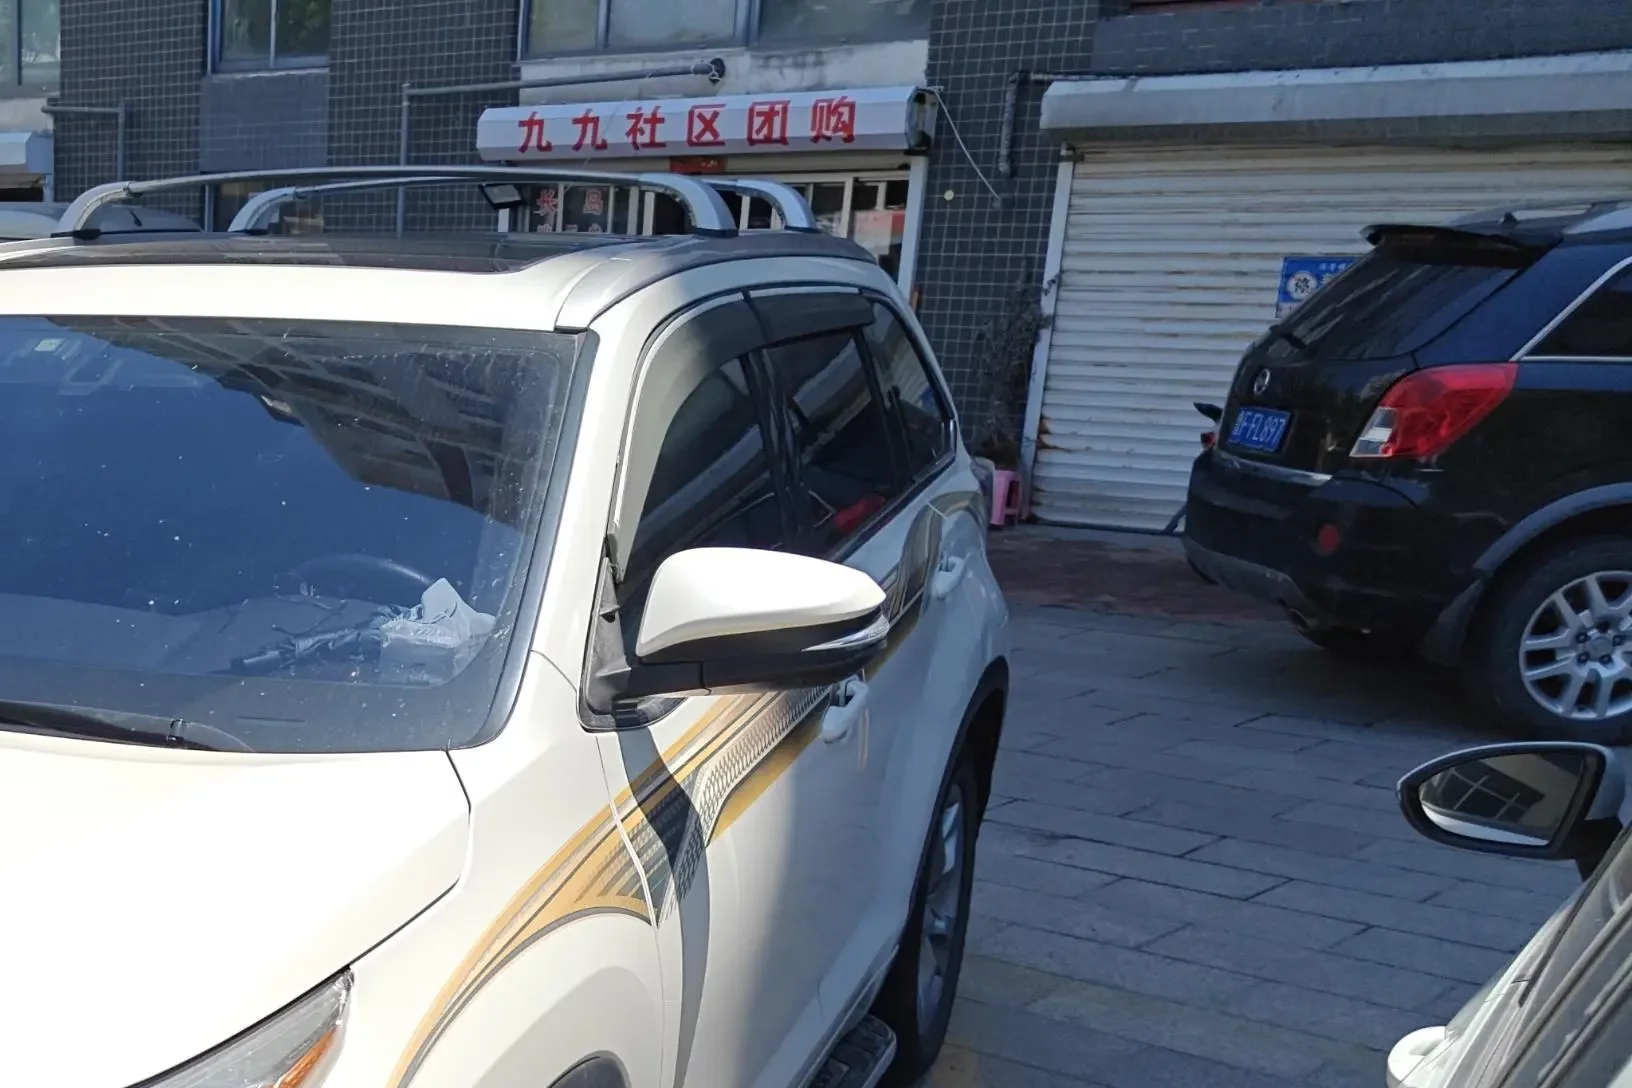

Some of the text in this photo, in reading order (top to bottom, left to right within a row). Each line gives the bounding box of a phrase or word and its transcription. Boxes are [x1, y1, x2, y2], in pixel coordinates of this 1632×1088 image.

[518, 95, 857, 153] 九九社区团购
